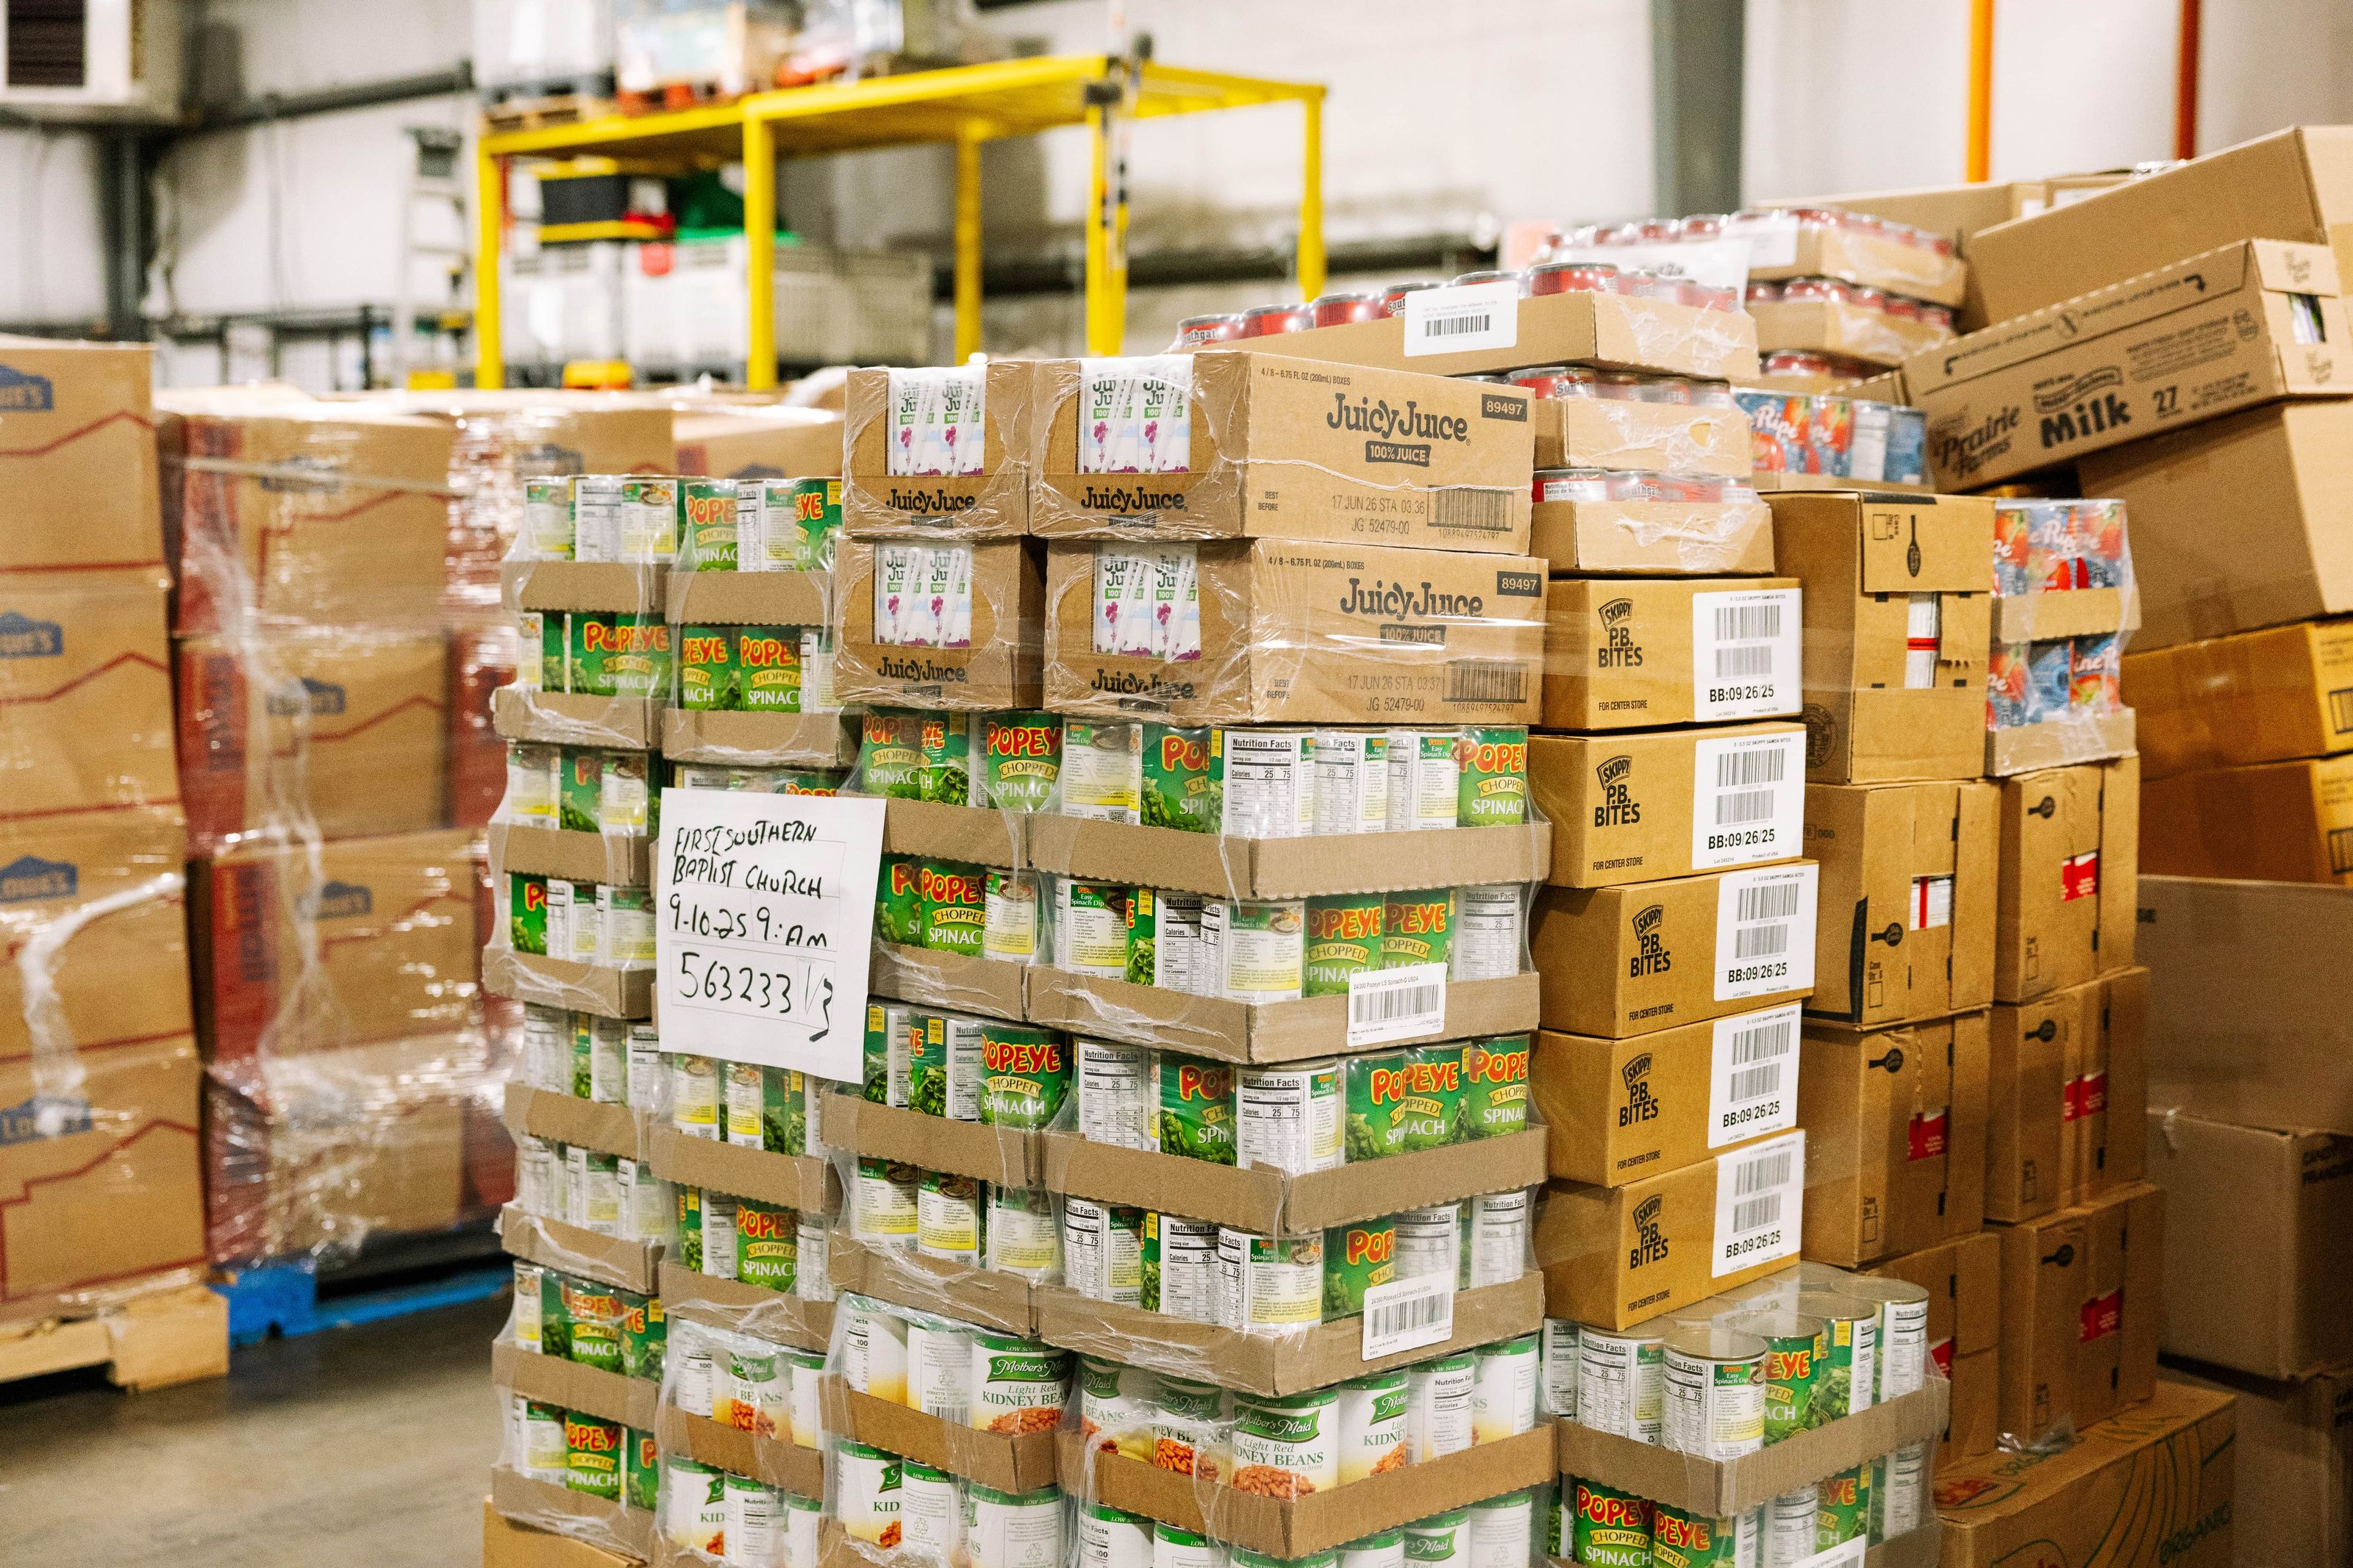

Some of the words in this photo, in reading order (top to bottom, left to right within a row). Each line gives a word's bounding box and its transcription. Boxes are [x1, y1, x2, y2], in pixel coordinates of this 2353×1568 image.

[1280, 370, 1293, 379] 6.75
[1293, 370, 1300, 379] FL
[1301, 371, 1309, 381] OZ
[1332, 374, 1351, 385] BOXES
[1486, 401, 1524, 415] 89497
[2152, 386, 2179, 414] 27
[2040, 394, 2132, 448] Milk
[1370, 445, 1395, 459] 100%
[1396, 446, 1427, 462] JUICE
[1265, 491, 1279, 500] BEST
[1332, 495, 1343, 509] 17
[1344, 496, 1363, 510] JUN
[1365, 498, 1377, 512] 26
[1379, 498, 1397, 513] STA
[1401, 501, 1425, 515] 03:36
[688, 496, 737, 525] POPE
[1258, 502, 1279, 512] BEFORE
[1352, 518, 1364, 532] JG
[1369, 519, 1410, 534] 52479-00
[1290, 558, 1304, 567] 6.75
[1305, 559, 1312, 567] FL
[1313, 559, 1321, 568] OZ
[1346, 562, 1365, 570] BOXES
[1502, 578, 1538, 592] 89497
[1606, 601, 1632, 625] SKIPPY
[1385, 629, 1410, 642] 100%
[1609, 627, 1634, 647] P.B.
[683, 637, 729, 664] PEYE
[741, 634, 801, 667] POPE
[1598, 645, 1643, 667] BITES
[1274, 679, 1290, 688] BEST
[1348, 676, 1357, 690] 17
[1360, 676, 1379, 690] JUN
[1382, 677, 1393, 690] 26
[1396, 677, 1413, 692] STA
[1417, 677, 1441, 692] 03:37
[1710, 684, 1774, 702] BB:09/26/25
[1366, 698, 1379, 711] JG
[1384, 698, 1424, 712] 52479-00
[1599, 701, 1609, 711] FOR
[1610, 700, 1630, 710] CENTER
[1631, 699, 1648, 709] STORE
[987, 723, 1063, 756] POPEY
[1232, 739, 1268, 748] Nutrition
[1270, 740, 1292, 748] Facts
[1001, 762, 1059, 779] CHOPPED
[1232, 770, 1251, 778] Calories
[1265, 770, 1274, 778] 25
[1282, 770, 1291, 778] 75
[1603, 759, 1631, 782] SKIPPY
[1606, 784, 1631, 805] P.B.
[1594, 802, 1640, 827] BITES
[674, 826, 724, 857] FIRST
[724, 820, 817, 851] SOUTHERN
[1708, 828, 1775, 849] BB:09/26/25
[1593, 860, 1604, 870] FOR
[1604, 859, 1625, 870] CENTER
[1626, 856, 1643, 867] STORE
[746, 865, 821, 899] CHURCH
[922, 867, 985, 904] POPE
[1071, 898, 1092, 906] Spinach
[1093, 900, 1104, 908] Dip
[1166, 898, 1201, 906] Nutrition
[1307, 906, 1381, 939] OPEYE
[1638, 907, 1662, 933] SKIPPY
[929, 928, 985, 946] SPINAC
[1640, 934, 1663, 955] P.B.
[1630, 951, 1671, 978] BITES
[1728, 962, 1788, 983] BB:09/26/25
[679, 952, 791, 1013] 563233
[1629, 1011, 1639, 1021] FOR
[1640, 1007, 1657, 1020] CENTER
[1658, 1003, 1674, 1015] STORE
[1471, 1050, 1528, 1084] POPE
[1628, 1056, 1651, 1082] SKIPPY
[989, 1077, 1038, 1094] CHOPPED
[1243, 1077, 1274, 1086] Nutrition
[1276, 1078, 1299, 1086] Facts
[1629, 1081, 1651, 1102] P.B.
[1243, 1107, 1260, 1117] Calories
[1273, 1109, 1282, 1117] 25
[1291, 1109, 1300, 1117] 75
[1619, 1098, 1659, 1127] BITES
[1723, 1100, 1780, 1128] BB:09/26/25
[1618, 1159, 1627, 1170] FOR
[1628, 1154, 1645, 1167] CENTER
[1646, 1150, 1660, 1163] STORE
[1638, 1198, 1661, 1224] SKIPPY
[1640, 1222, 1661, 1245] P.B.
[1630, 1239, 1669, 1269] BITES
[1726, 1230, 1781, 1259] BB:09/26/25
[1628, 1301, 1637, 1312] FOR
[1638, 1295, 1655, 1309] CENTER
[1656, 1289, 1671, 1303] STORE
[993, 1359, 1043, 1375] Mother's
[1681, 1361, 1703, 1372] Facts
[1008, 1385, 1035, 1395] Light
[1040, 1382, 1057, 1392] Red
[1678, 1388, 1686, 1397] 25
[1694, 1392, 1702, 1400] 75
[982, 1391, 1036, 1407] KIDNEY
[1272, 1418, 1313, 1436] Maid
[1235, 1444, 1270, 1465] IDNEY
[1274, 1451, 1324, 1466] BEANS
[1244, 1438, 1268, 1451] Light
[1273, 1442, 1294, 1453] Red
[1577, 1486, 1655, 1528] POPEY
[1592, 1530, 1647, 1547] CHOPPED
